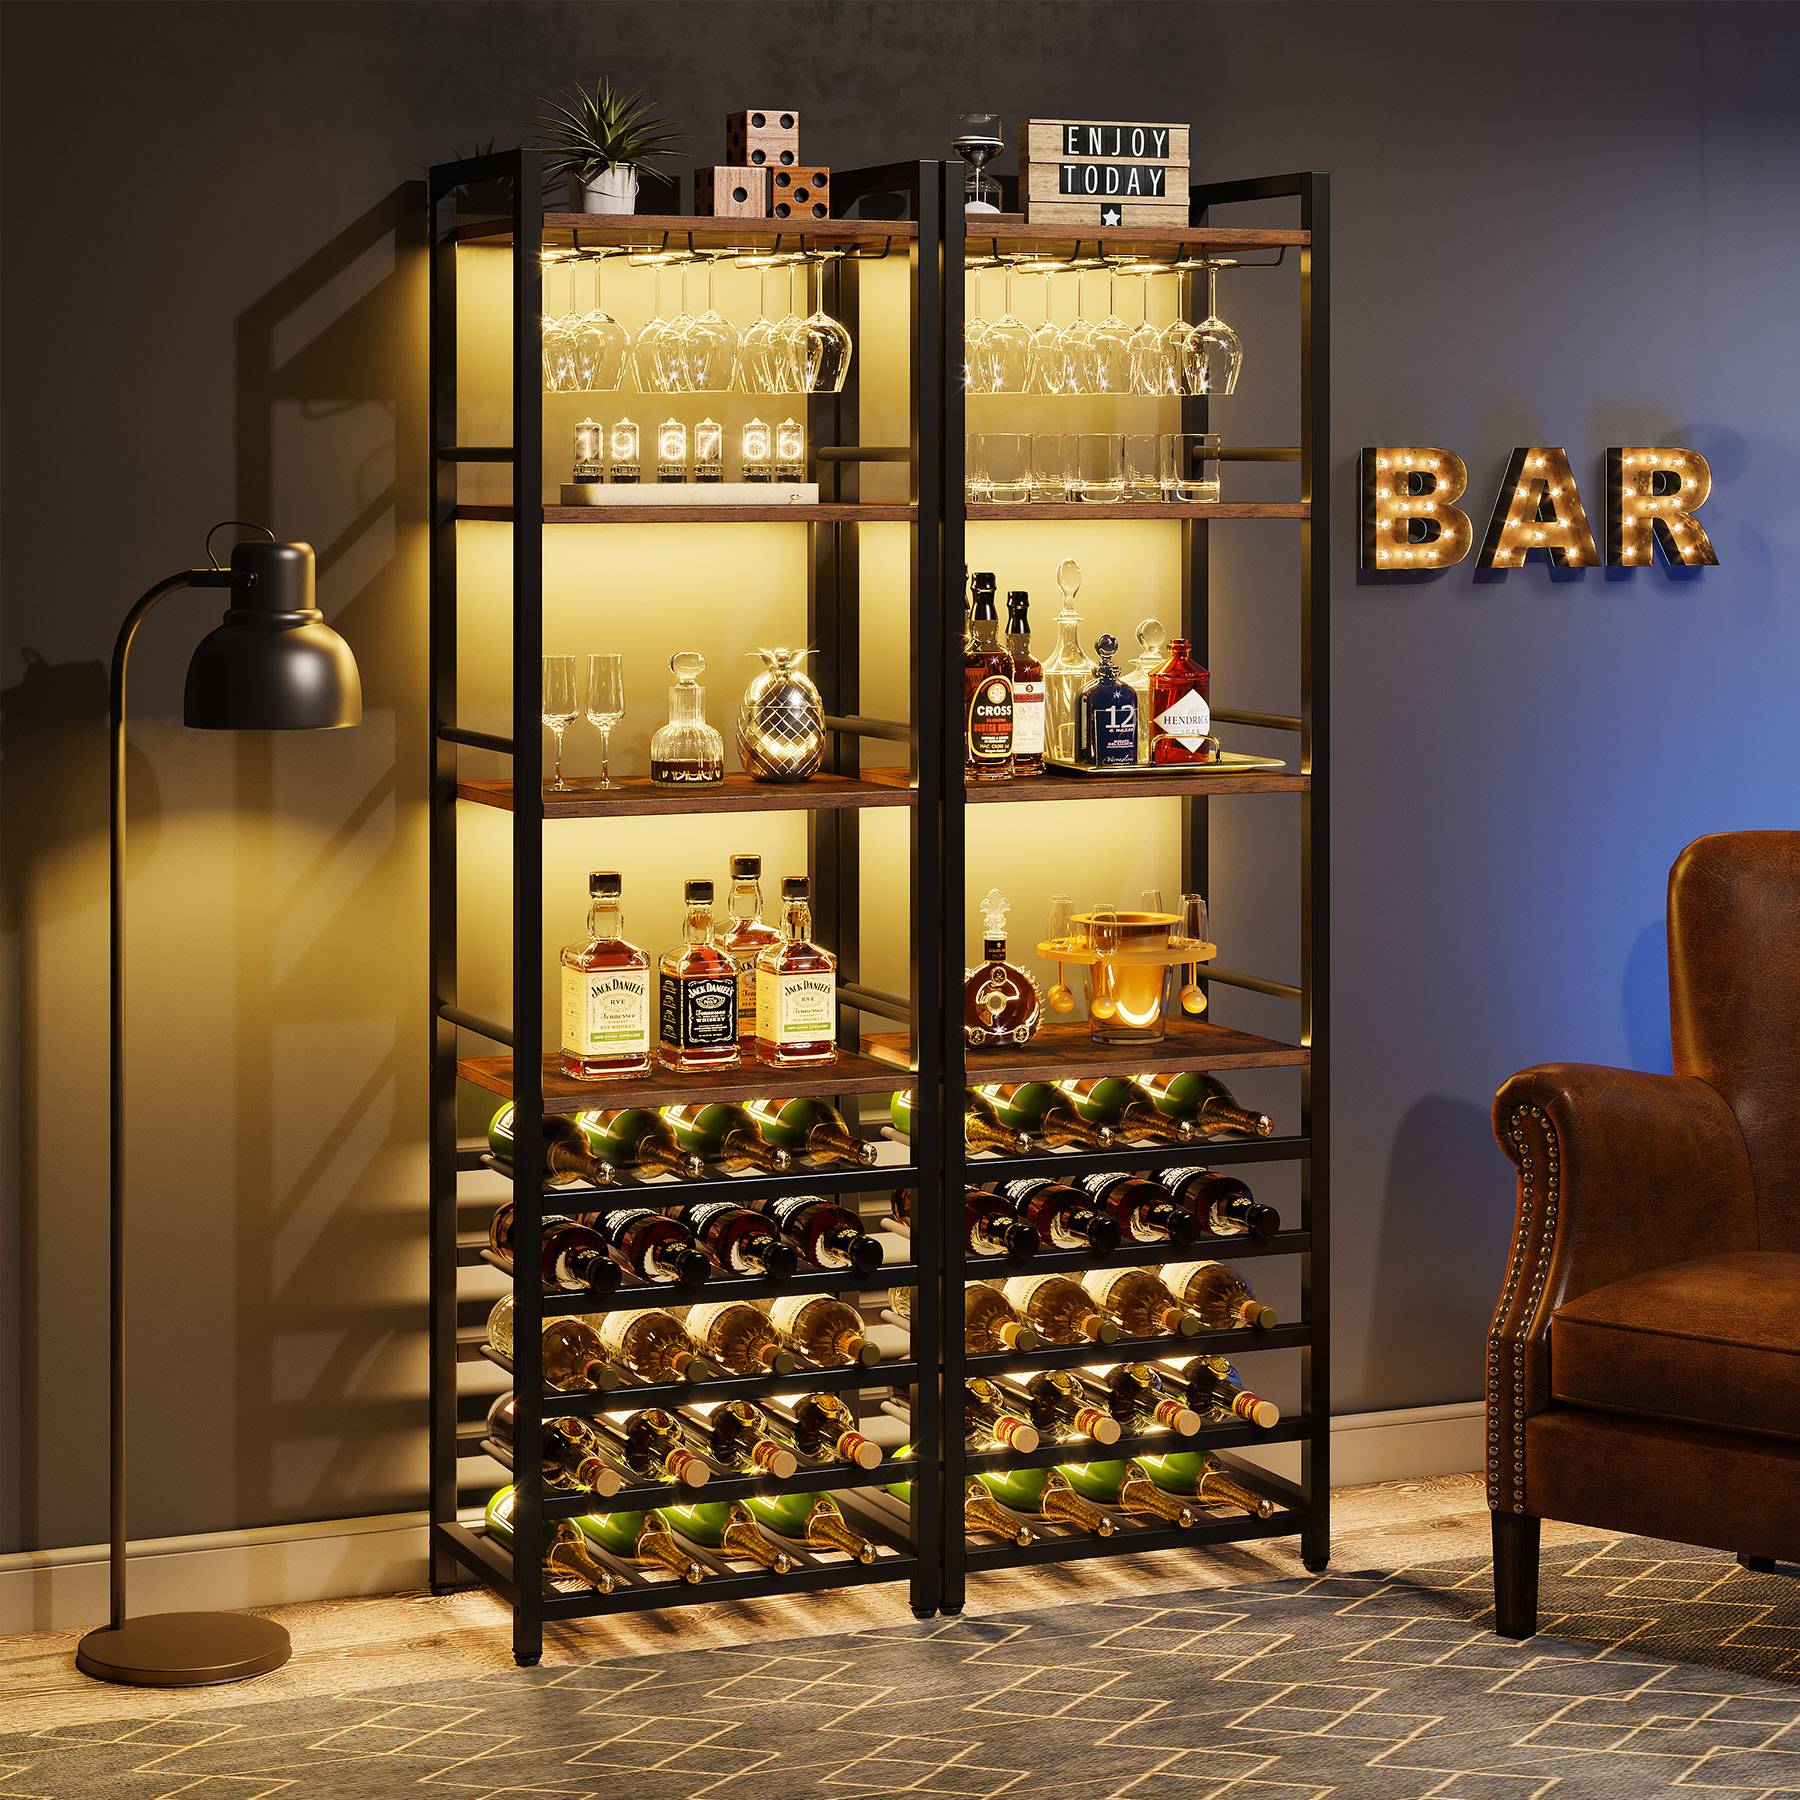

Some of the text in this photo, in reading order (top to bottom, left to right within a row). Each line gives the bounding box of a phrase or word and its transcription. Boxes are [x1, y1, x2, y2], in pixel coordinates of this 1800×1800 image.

[1067, 126, 1166, 158] ENJOY
[1063, 165, 1163, 196] TODAY
[1360, 447, 1720, 569] BAR
[976, 705, 1012, 716] CROSS
[1105, 704, 1136, 729] 12
[591, 978, 646, 999] JACK DANIEL'S
[687, 984, 706, 999] JACK
[706, 982, 736, 997] DANIEL'S
[784, 980, 832, 997] JACK DANIEL'S
[610, 998, 626, 1006] RYE
